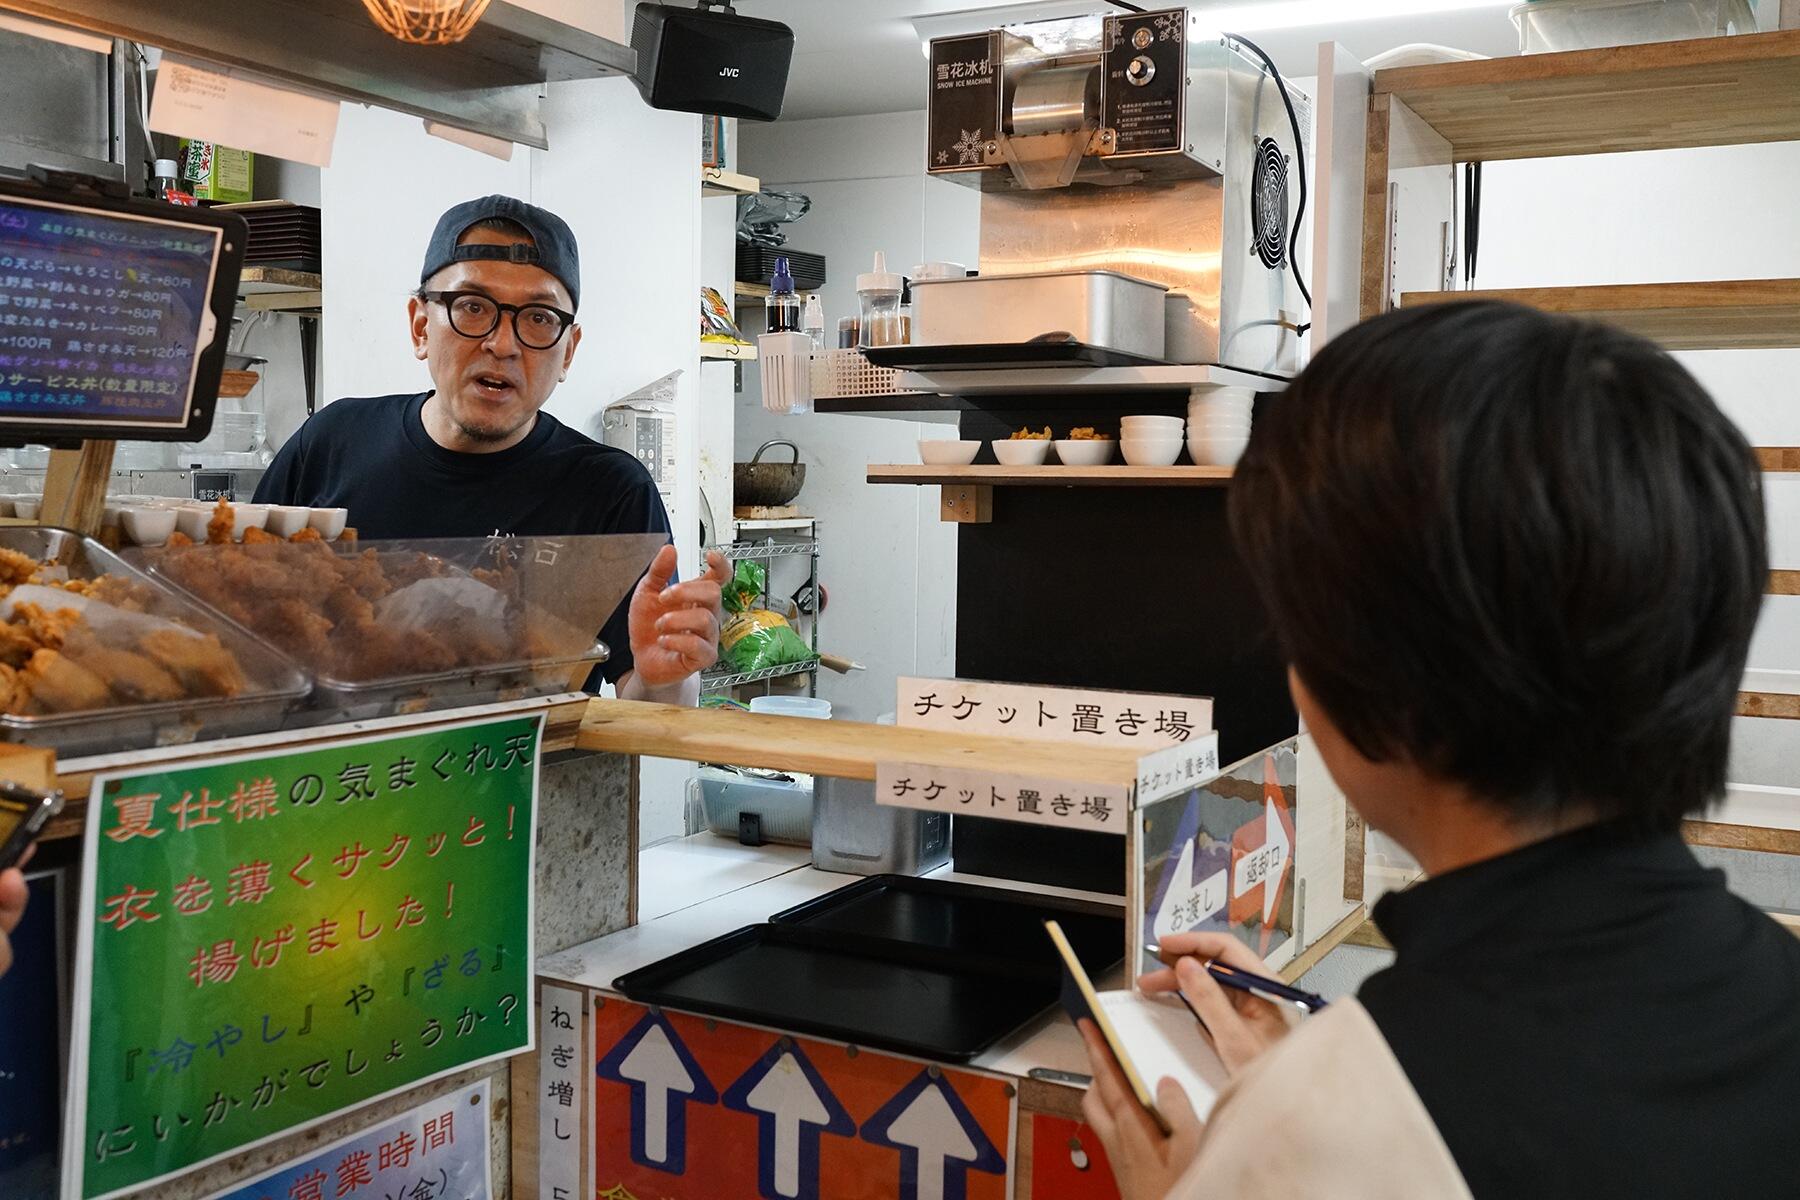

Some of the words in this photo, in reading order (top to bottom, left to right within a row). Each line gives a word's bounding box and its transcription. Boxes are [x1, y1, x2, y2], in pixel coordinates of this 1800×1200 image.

[719, 67, 740, 78] JVC
[937, 59, 993, 79] 雪花冰机
[937, 81, 954, 89] SNOW
[966, 77, 992, 86] MACHINE
[186, 140, 204, 178] 茶蜜
[914, 693, 1195, 742] チケット置き場
[106, 735, 533, 842] 夏仕様の気まぐれ天
[1140, 750, 1216, 794] チケット置き場
[893, 778, 1114, 823] チケット置き場
[98, 804, 515, 930] 衣を薄くサクッと！
[1246, 846, 1280, 884] 返却口
[1171, 888, 1214, 932] お渡し
[188, 882, 454, 988] 揚げました！
[95, 993, 518, 1163] にいかがでしょうか？
[548, 1006, 574, 1140] ねぎ増し
[258, 1111, 455, 1200] 営業時間
